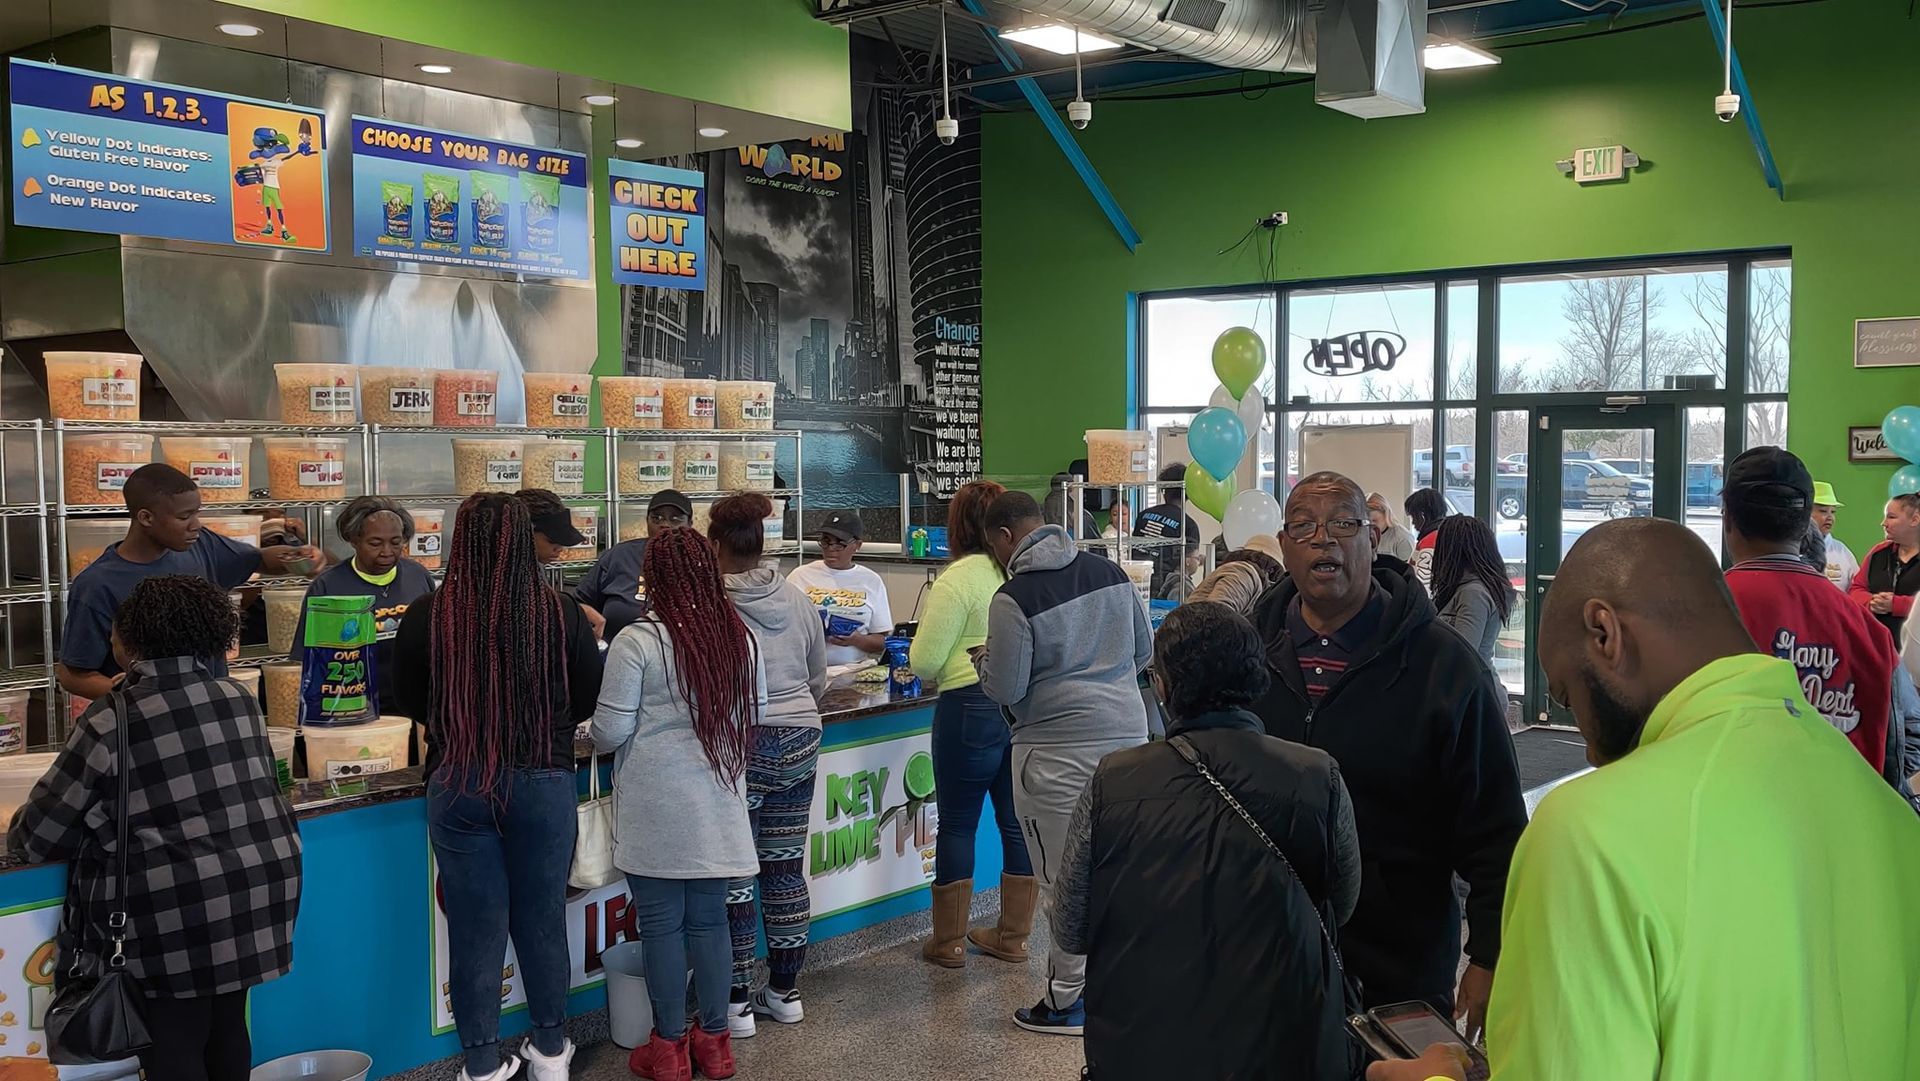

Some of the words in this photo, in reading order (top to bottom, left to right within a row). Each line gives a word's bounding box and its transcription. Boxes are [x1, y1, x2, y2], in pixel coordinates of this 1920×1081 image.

[89, 84, 126, 112] AS
[143, 91, 208, 125] 1.2.3.
[45, 128, 100, 147] Yellow
[106, 137, 133, 151] Dot
[137, 141, 212, 162] Indicates:
[362, 128, 433, 154] CHOOSE
[441, 140, 490, 164] YOUR
[496, 150, 530, 169] BAG
[536, 155, 571, 175] SIZE
[48, 145, 100, 162] Gluten
[103, 153, 139, 167] Free
[142, 156, 190, 172] Flavor
[1583, 149, 1616, 176] EXIT
[46, 174, 105, 192] Orange
[108, 181, 137, 195] Dot
[140, 184, 216, 205] Indicates:
[613, 180, 698, 213] CHECK
[768, 180, 782, 189] THE
[782, 182, 805, 192] WORLD
[49, 192, 85, 208] New
[90, 197, 140, 213] Flavor
[626, 212, 688, 246] OUT
[620, 246, 697, 278] HERE
[935, 316, 980, 346] Change
[935, 343, 948, 356] will
[949, 345, 960, 356] not
[961, 347, 980, 358] come
[935, 371, 951, 382] other
[952, 373, 972, 385] person
[973, 374, 980, 383] or
[392, 390, 430, 409] JERK
[935, 386, 951, 395] some
[951, 385, 965, 396] other
[936, 399, 944, 408] We
[945, 400, 954, 408] are
[955, 399, 964, 408] the
[965, 401, 978, 409] ones
[936, 409, 958, 424] we've
[959, 409, 979, 424] been
[935, 425, 966, 443] waiting
[967, 425, 980, 440] for.
[936, 441, 949, 458] We
[951, 446, 966, 458] are
[967, 443, 981, 458] the
[301, 464, 322, 473] HOT
[936, 459, 965, 476] change
[966, 459, 981, 473] that
[936, 477, 951, 490] we
[1161, 516, 1180, 529] LANE
[1775, 630, 1839, 679] Gary
[326, 660, 365, 684] 250
[1801, 673, 1855, 715] Dept
[826, 767, 889, 821] KEY
[810, 818, 881, 877] LIME
[895, 803, 938, 856] PIE
